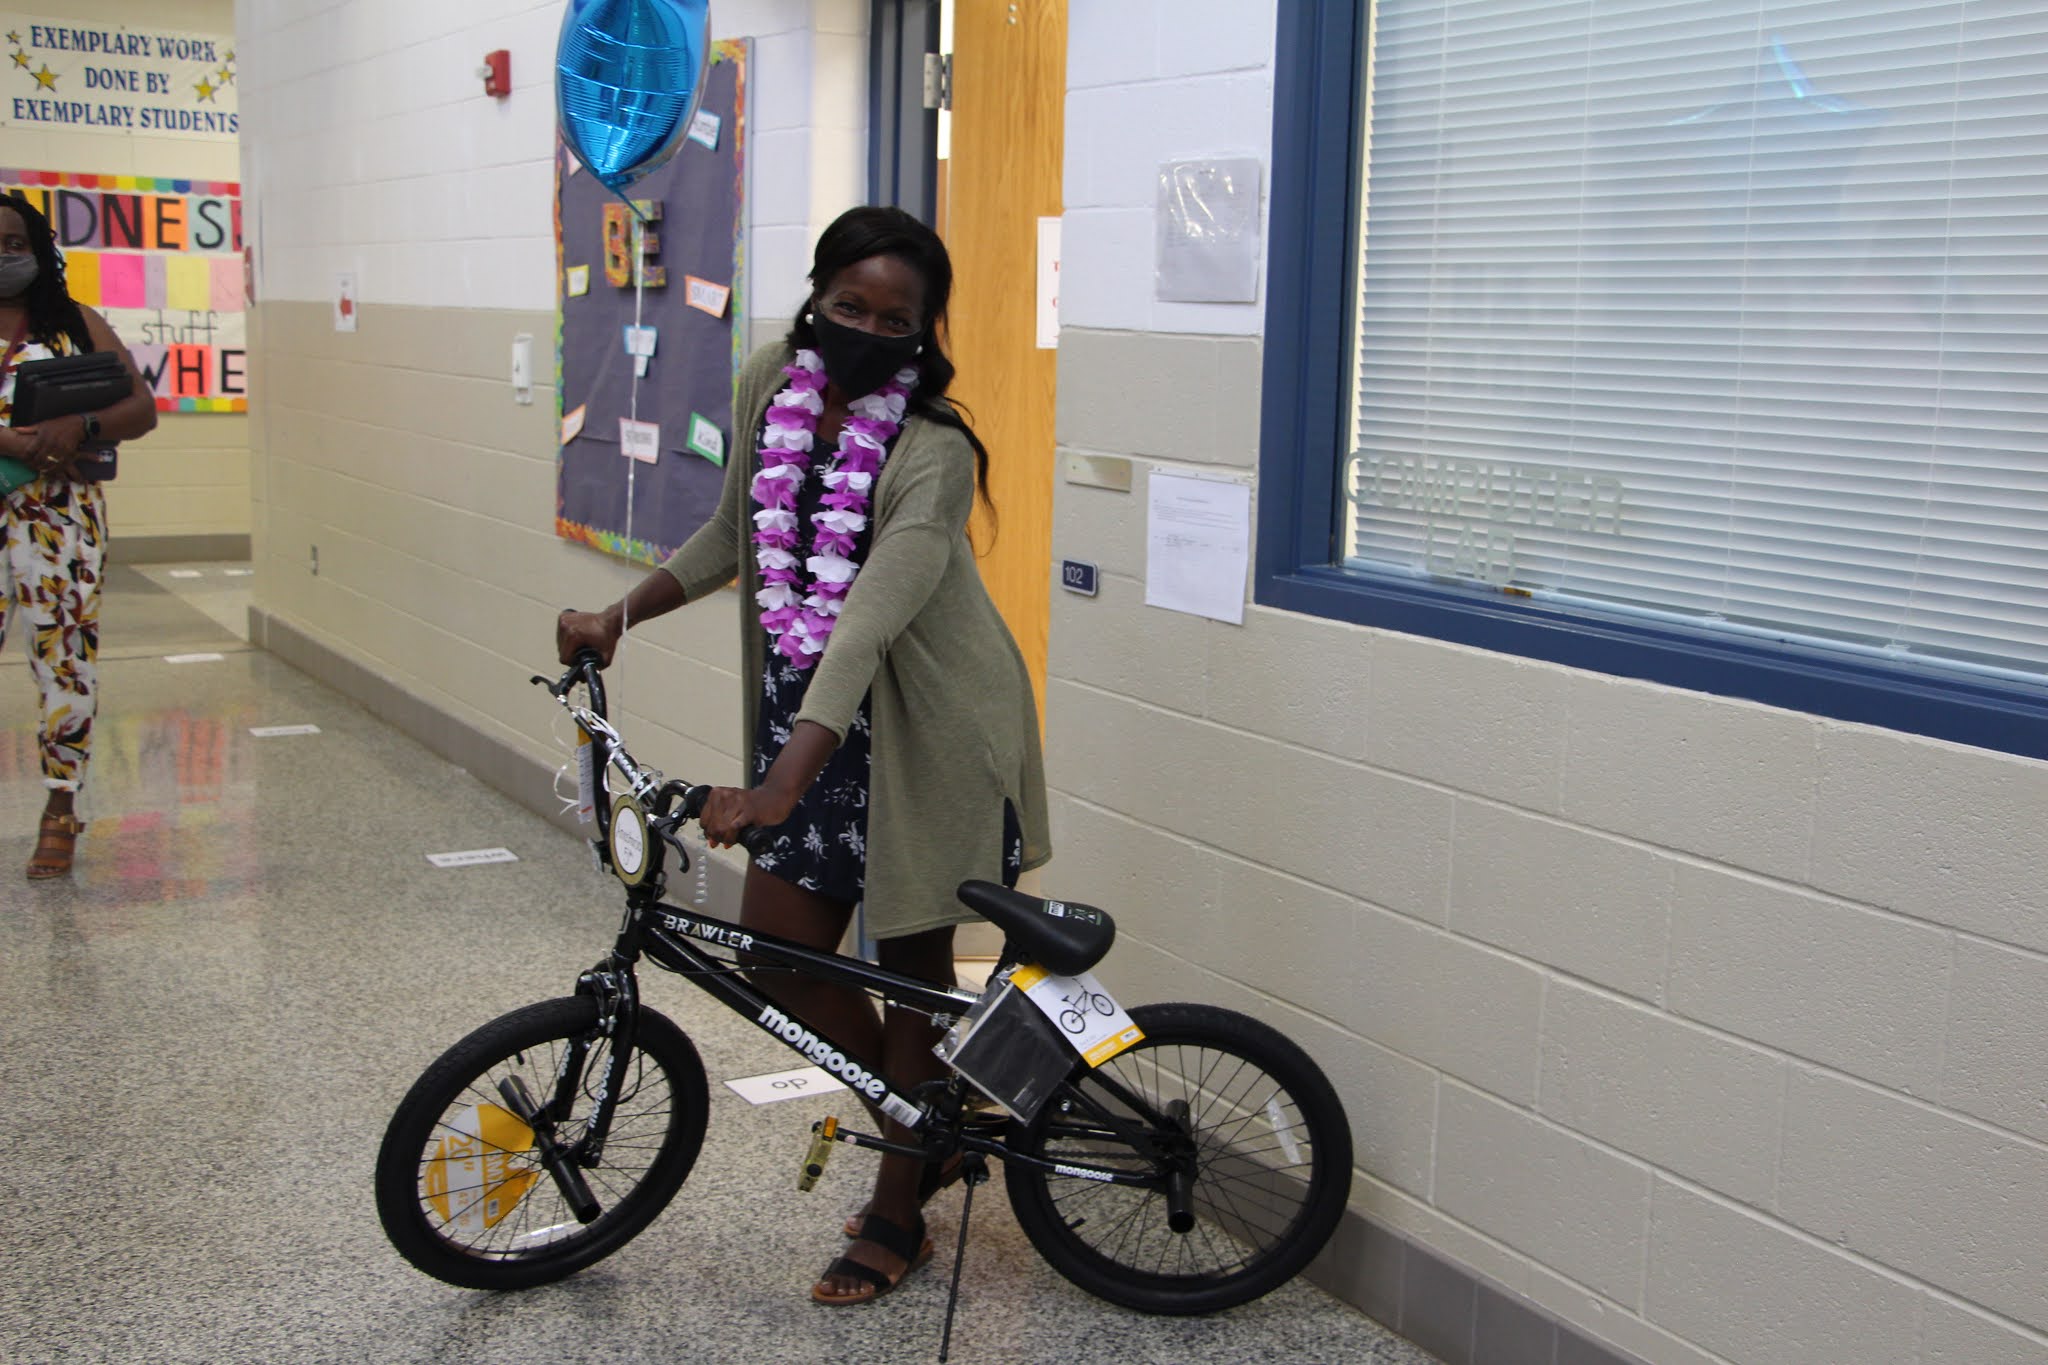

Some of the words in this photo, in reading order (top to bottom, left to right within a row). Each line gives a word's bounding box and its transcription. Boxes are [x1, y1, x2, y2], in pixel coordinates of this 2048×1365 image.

[31, 25, 152, 57] EXEMPLARY
[156, 37, 218, 63] WORK
[85, 67, 140, 92] DONE
[146, 72, 170, 94] BY
[13, 98, 135, 127] EXEMPLARY
[140, 108, 239, 134] STUDENTS
[8, 189, 242, 251] DNES
[603, 200, 667, 288] BE
[142, 309, 219, 345] stuff
[1343, 451, 1625, 536] COMPUTER
[1426, 521, 1516, 586] LAB
[1064, 565, 1084, 585] 102
[663, 914, 754, 951] BRAWLER
[757, 1005, 887, 1099] mongoose
[1054, 1163, 1114, 1182] mongoose
